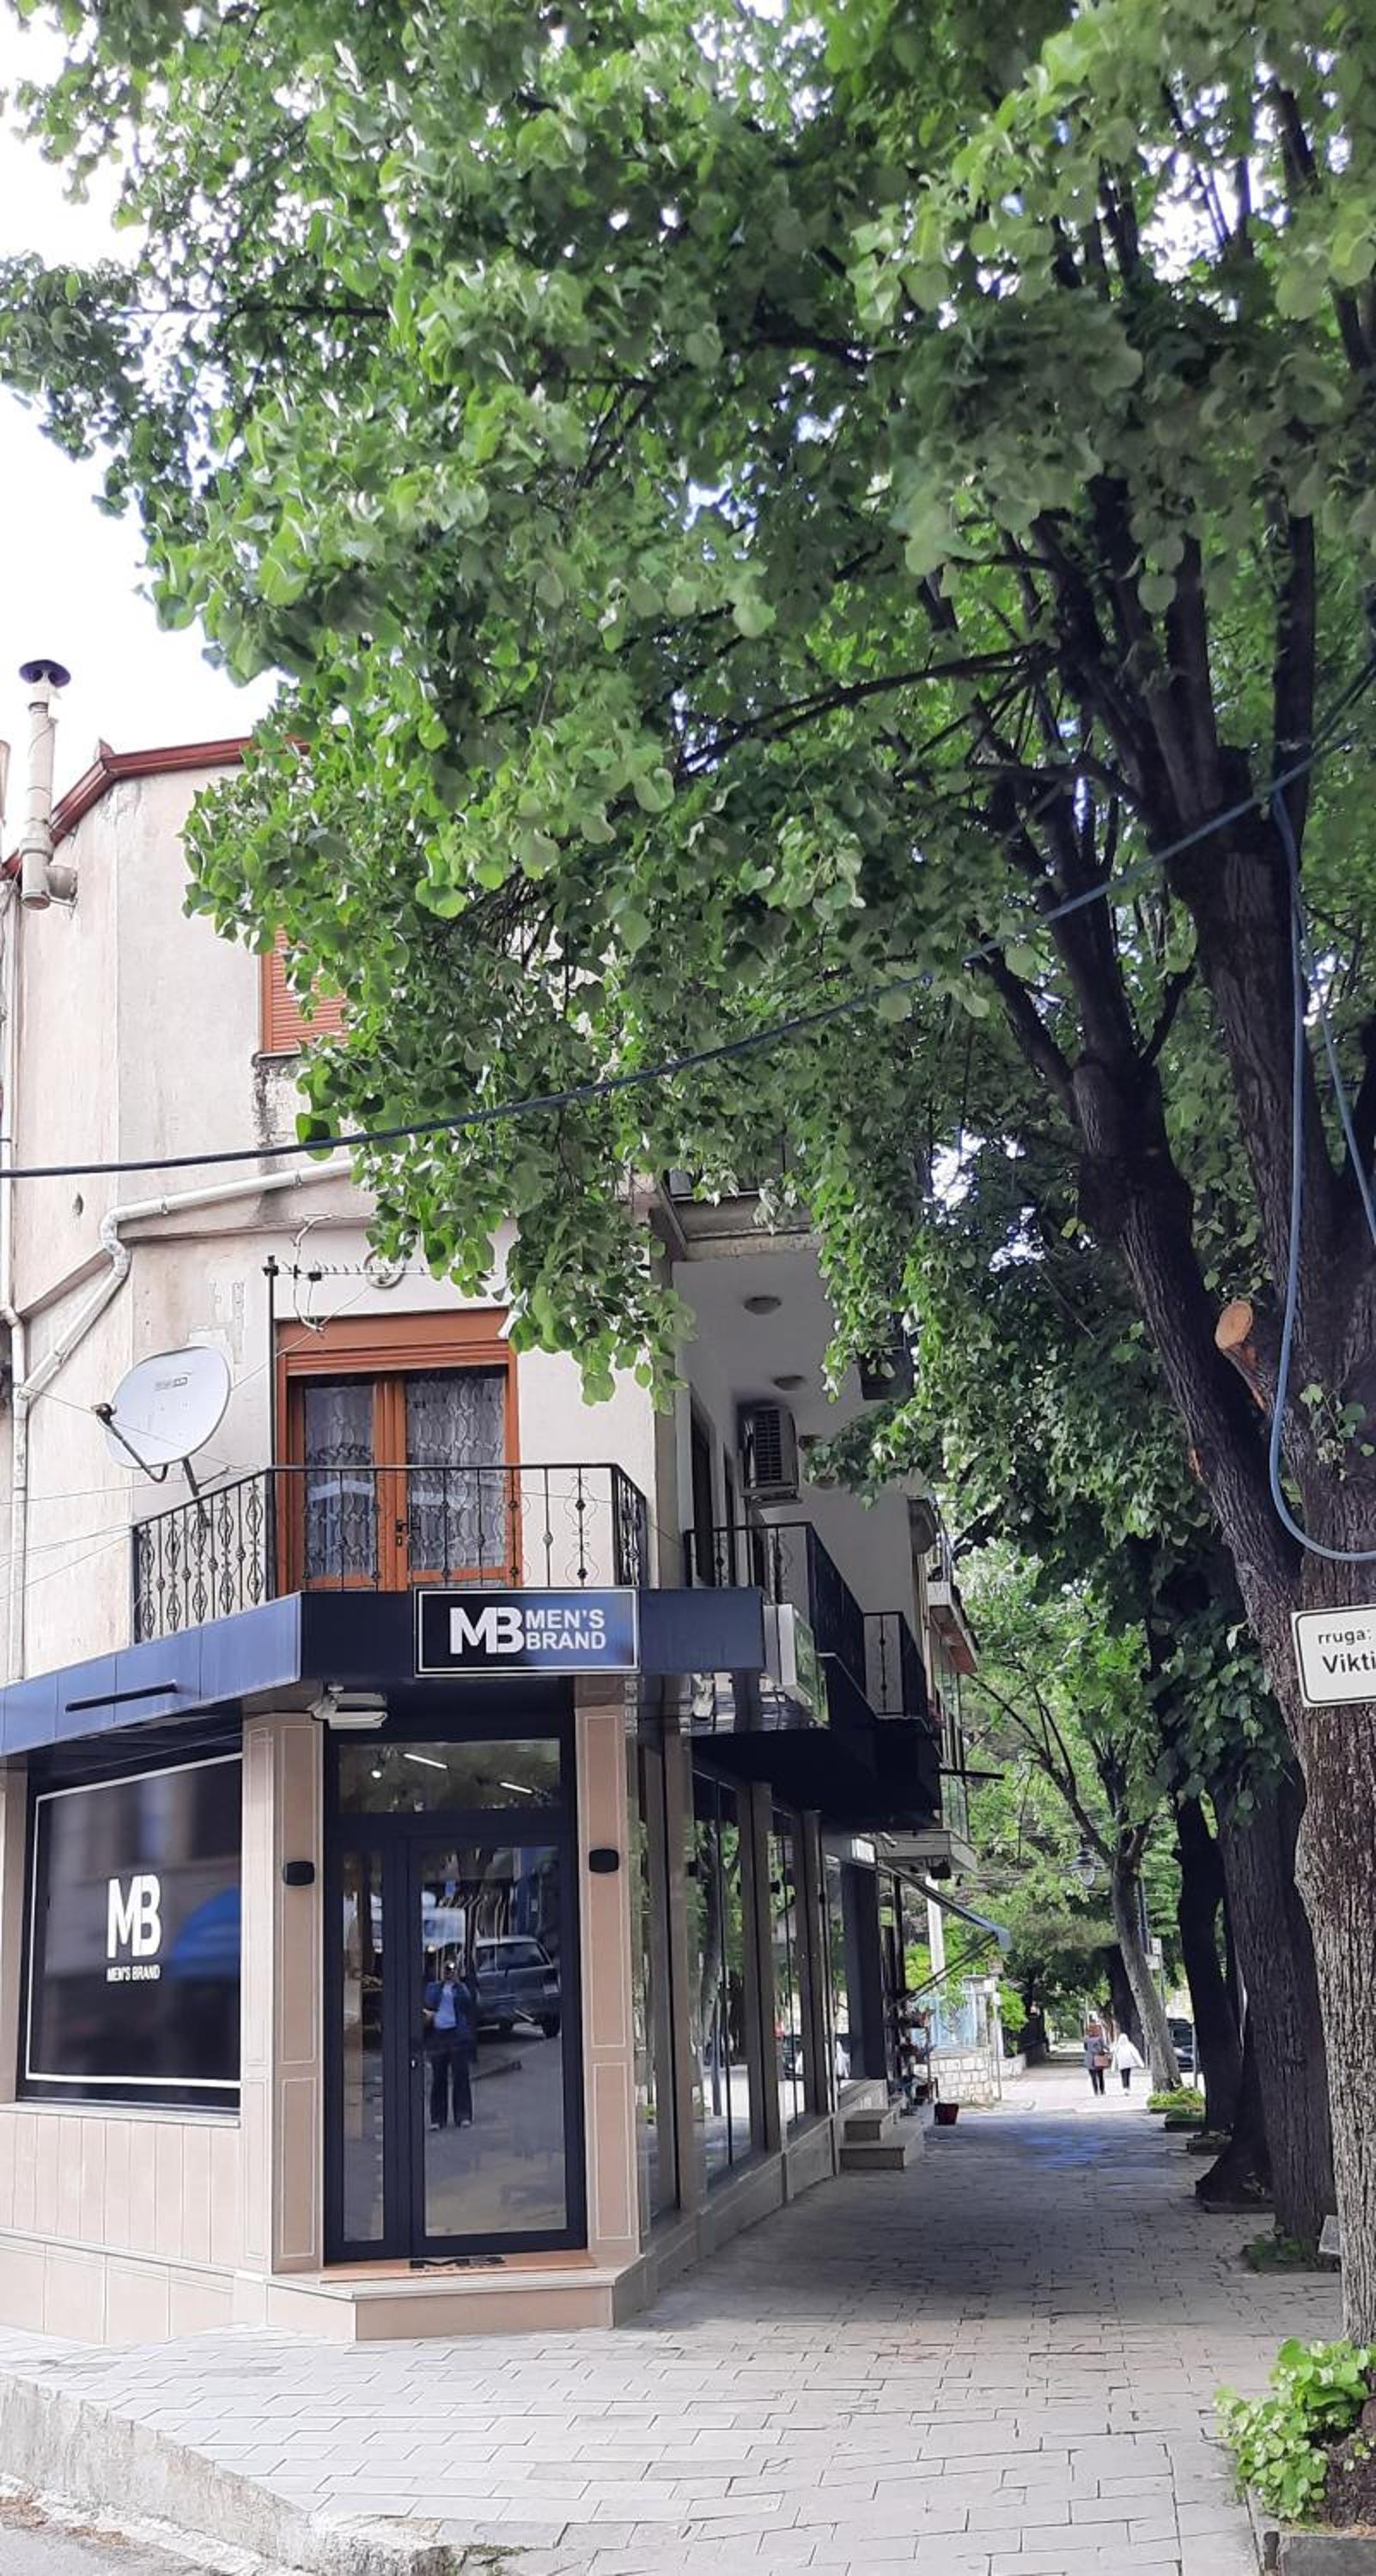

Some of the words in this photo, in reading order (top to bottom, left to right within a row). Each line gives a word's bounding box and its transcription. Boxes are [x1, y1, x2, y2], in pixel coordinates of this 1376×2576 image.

[526, 1609, 605, 1630] MEN'S
[449, 1607, 525, 1655] MB
[526, 1631, 606, 1649] BRAND
[1318, 1629, 1372, 1645] rruga:
[107, 1874, 161, 1959] MB
[107, 1965, 131, 1983] MEN'S
[131, 1964, 161, 1982] BRAND
